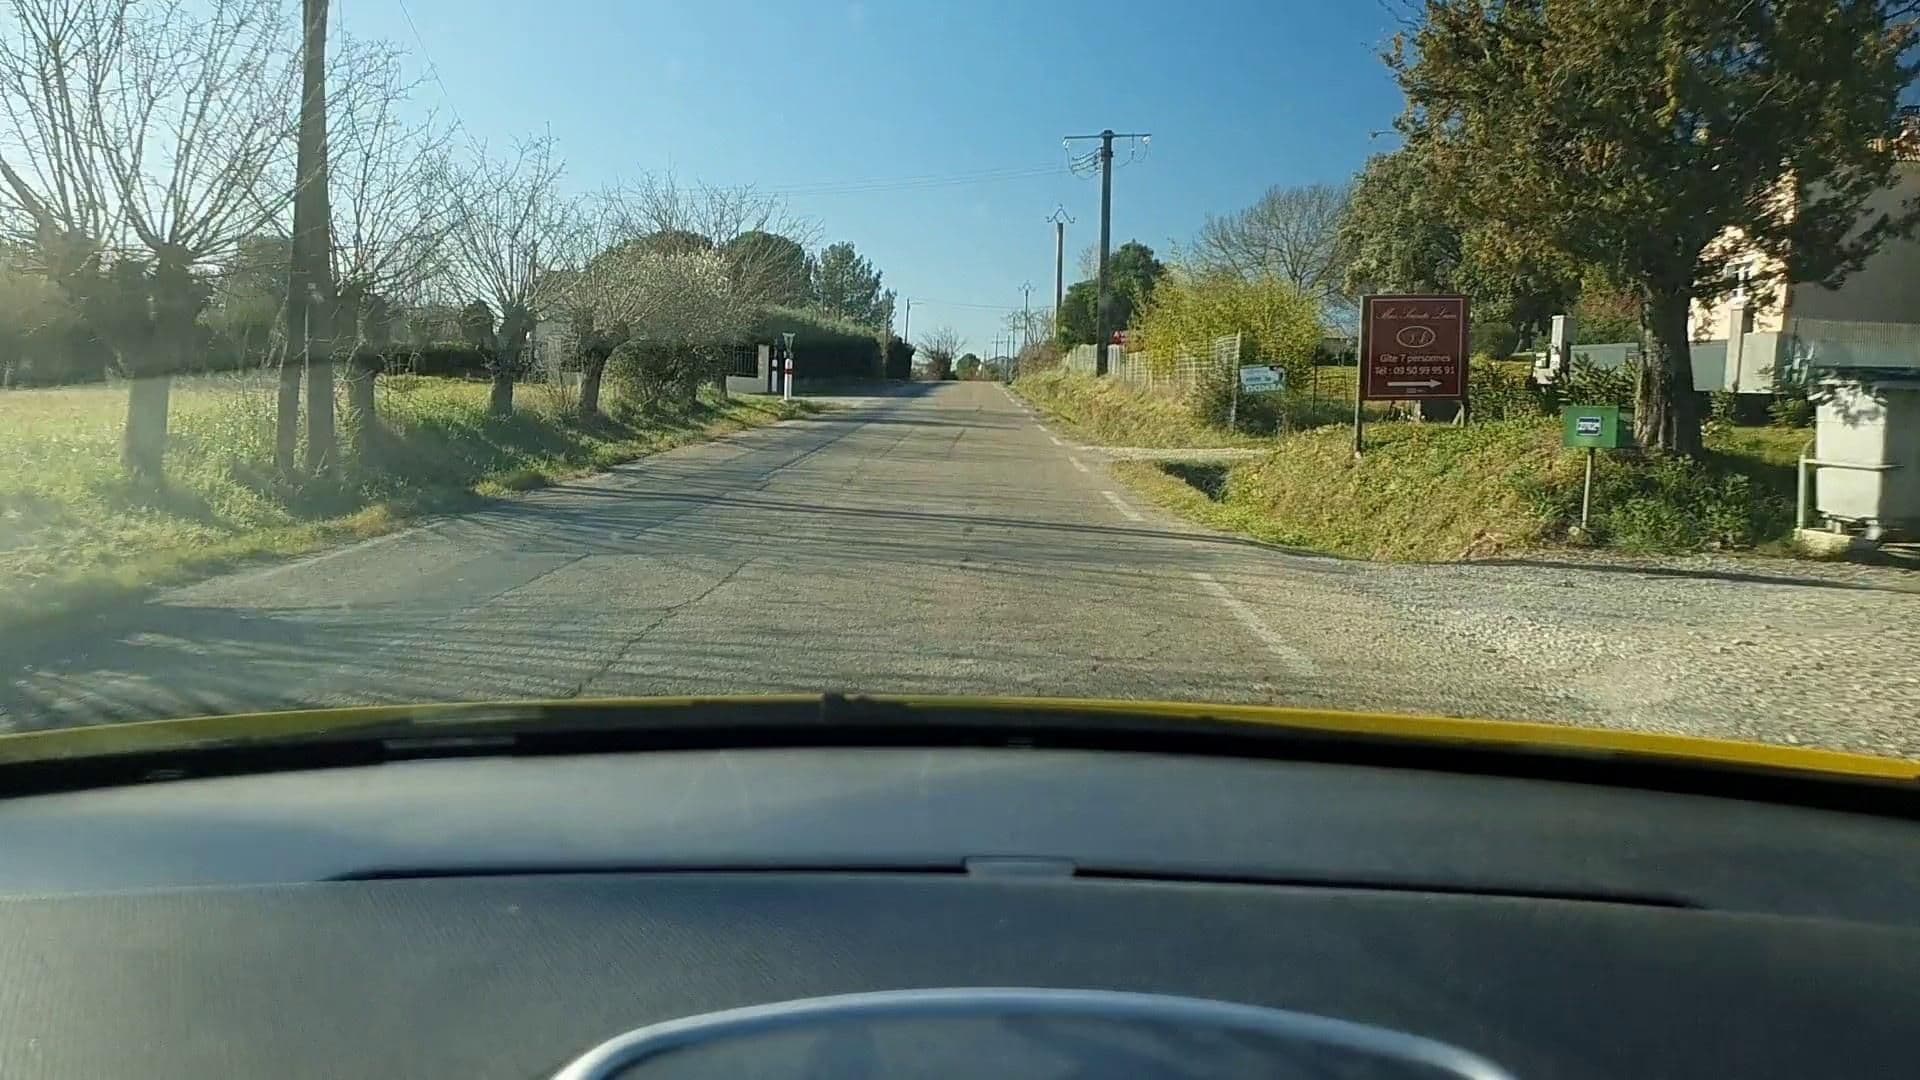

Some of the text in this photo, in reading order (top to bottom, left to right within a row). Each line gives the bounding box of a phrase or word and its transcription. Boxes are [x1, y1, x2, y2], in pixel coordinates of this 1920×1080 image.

[1400, 354, 1406, 362] 7
[1407, 355, 1450, 363] personnes
[1406, 366, 1417, 375] 50
